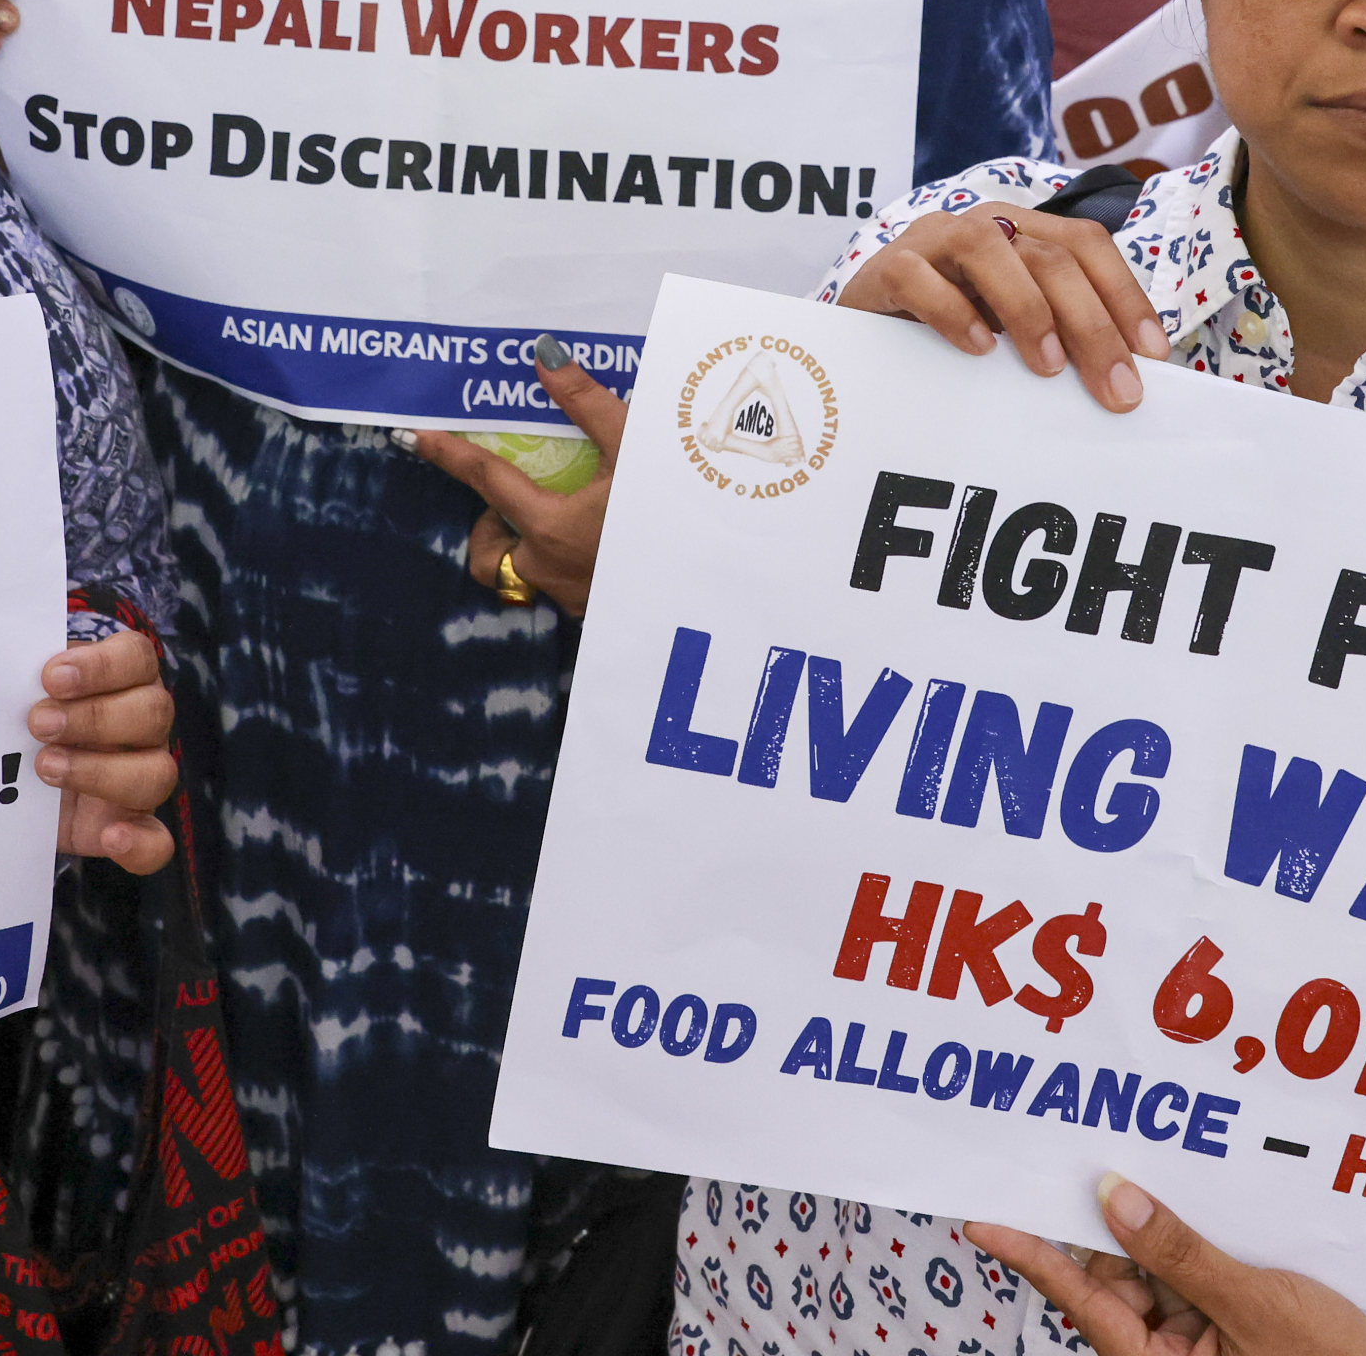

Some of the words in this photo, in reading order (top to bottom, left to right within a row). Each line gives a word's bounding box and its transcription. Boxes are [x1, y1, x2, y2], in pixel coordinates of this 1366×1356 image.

[24, 94, 194, 171] STOP
[209, 113, 877, 220] DISCRIMINATION!
[220, 315, 313, 352] ASIAN
[319, 326, 487, 367] MIGRANTS
[677, 335, 753, 428] MIGRANTS'
[760, 335, 838, 470] COORDINATING
[681, 435, 732, 490] ASIAN
[735, 401, 774, 437] AMCB
[750, 469, 810, 499] BODY
[849, 469, 1278, 658] FIGHT
[644, 625, 1173, 855] LIVING
[831, 870, 1109, 1036] HK$
[561, 975, 759, 1066] FOOD
[780, 1014, 1243, 1162] ALLOWANCE
